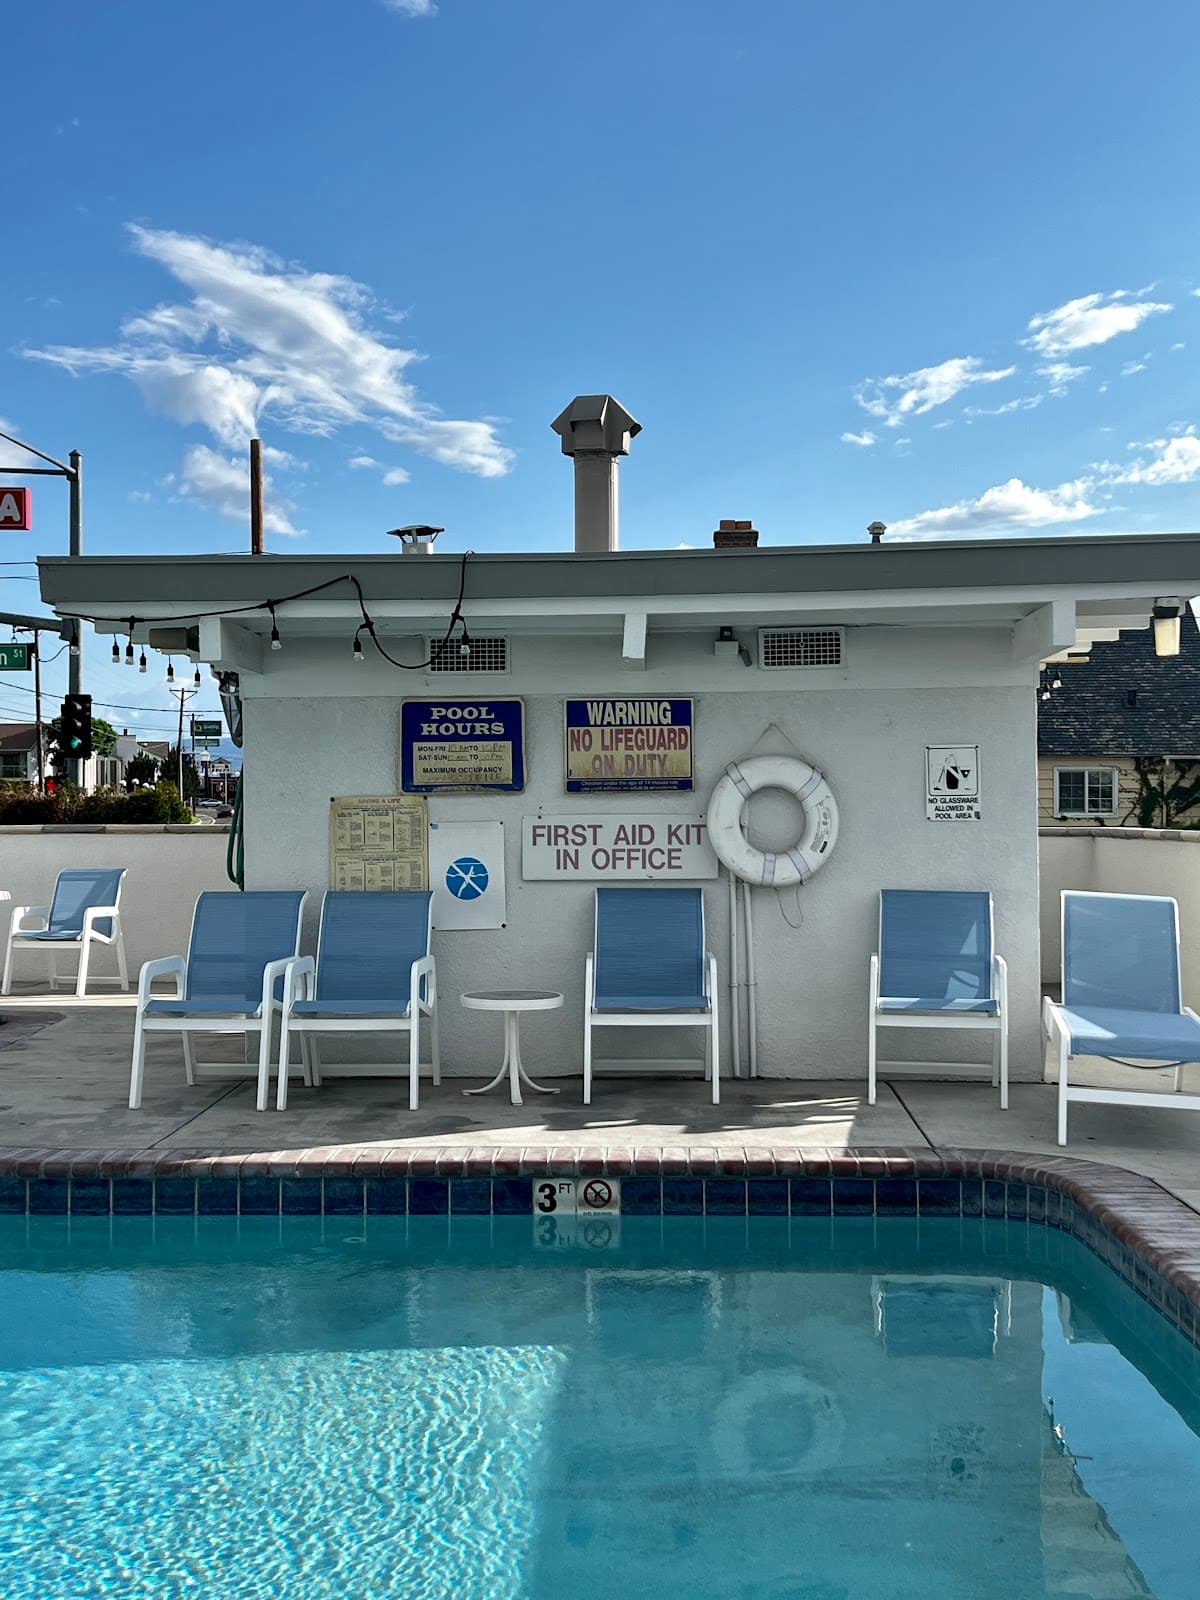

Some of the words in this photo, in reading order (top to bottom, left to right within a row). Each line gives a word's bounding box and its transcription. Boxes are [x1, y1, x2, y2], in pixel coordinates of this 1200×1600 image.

[0, 493, 21, 522] A
[13, 649, 23, 658] St
[430, 706, 495, 720] POOL
[586, 701, 672, 726] WARNING
[420, 722, 505, 736] HOURS
[570, 728, 593, 752] NO
[600, 727, 689, 752] LIFEGUARD
[591, 754, 615, 777] ON
[623, 753, 668, 777] DUTY
[532, 824, 603, 846] FIRST
[613, 824, 655, 846] AID
[667, 823, 708, 846] KIT
[556, 848, 579, 870] IN
[591, 848, 683, 870] OFFICE
[538, 1183, 557, 1213] 3
[558, 1182, 572, 1194] FT
